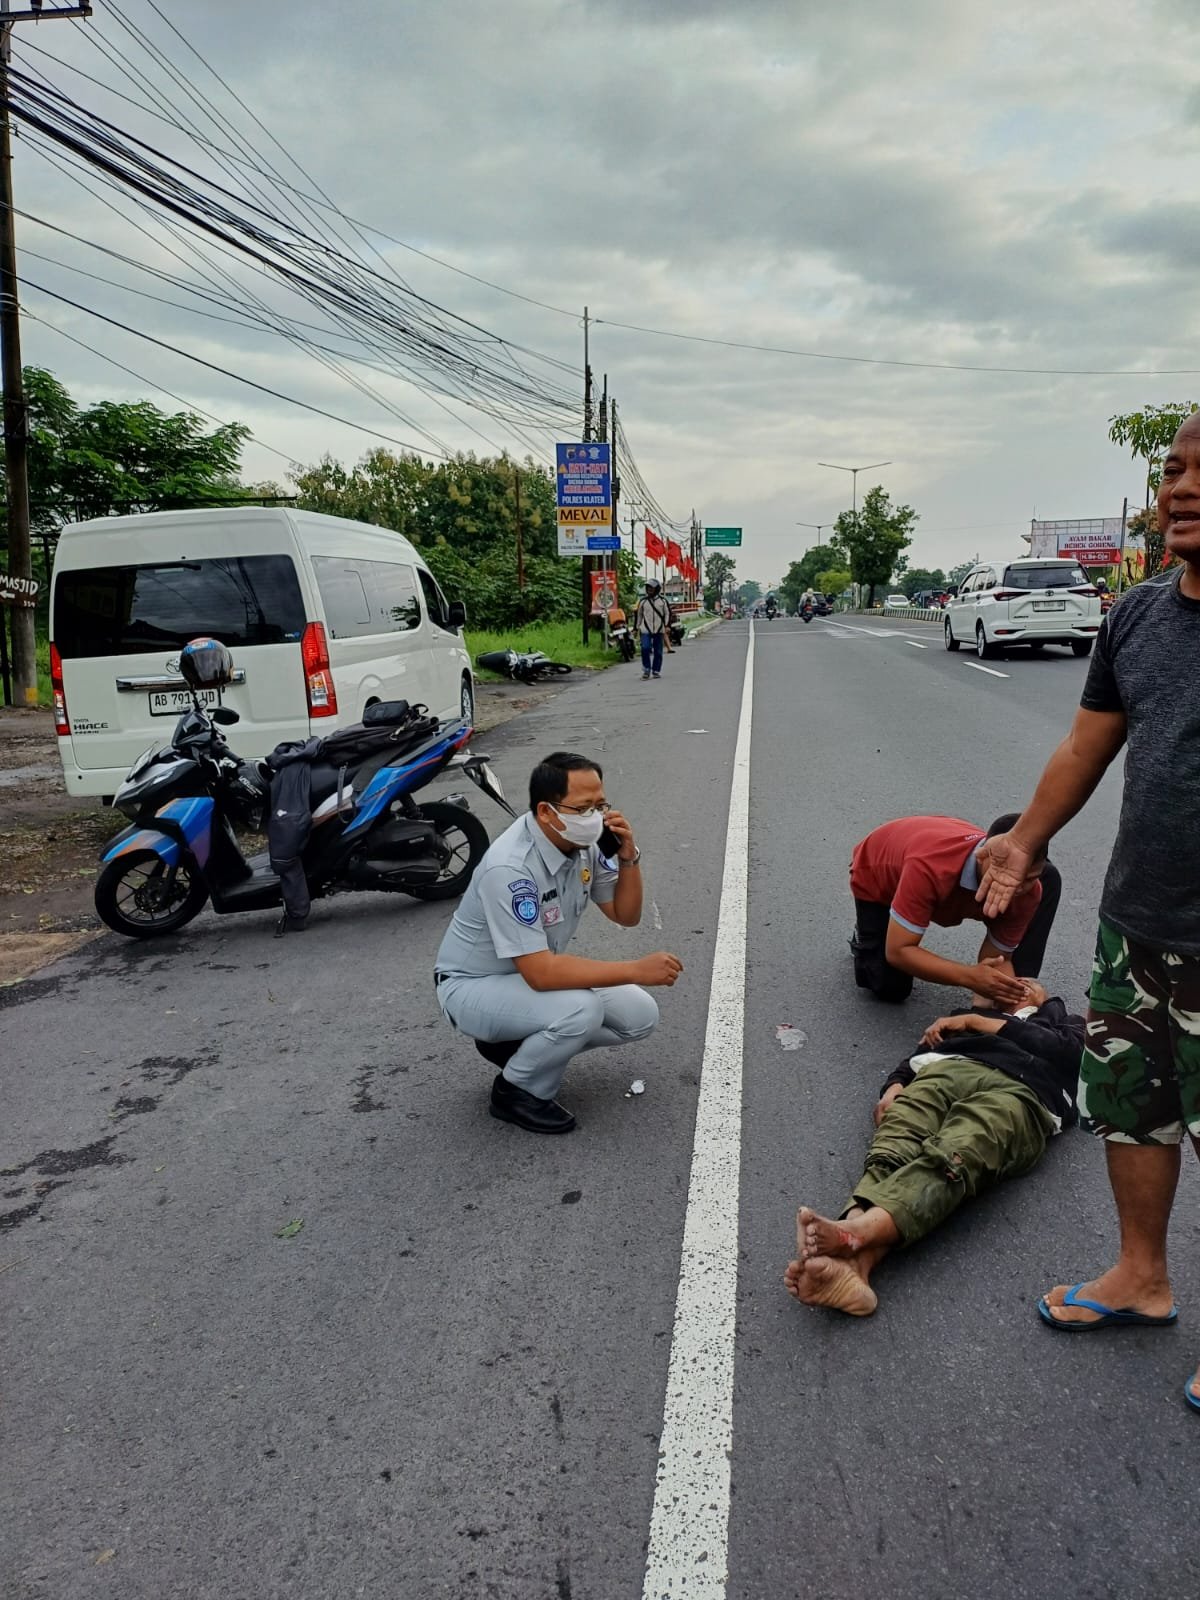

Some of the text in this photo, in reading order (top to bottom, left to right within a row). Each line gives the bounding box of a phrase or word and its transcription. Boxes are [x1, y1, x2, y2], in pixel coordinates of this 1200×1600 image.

[583, 495, 605, 504] KLATEN
[560, 509, 608, 521] MEVAL
[0, 574, 39, 596] MASJID
[155, 693, 168, 707] AB
[73, 722, 109, 730] HIACE
